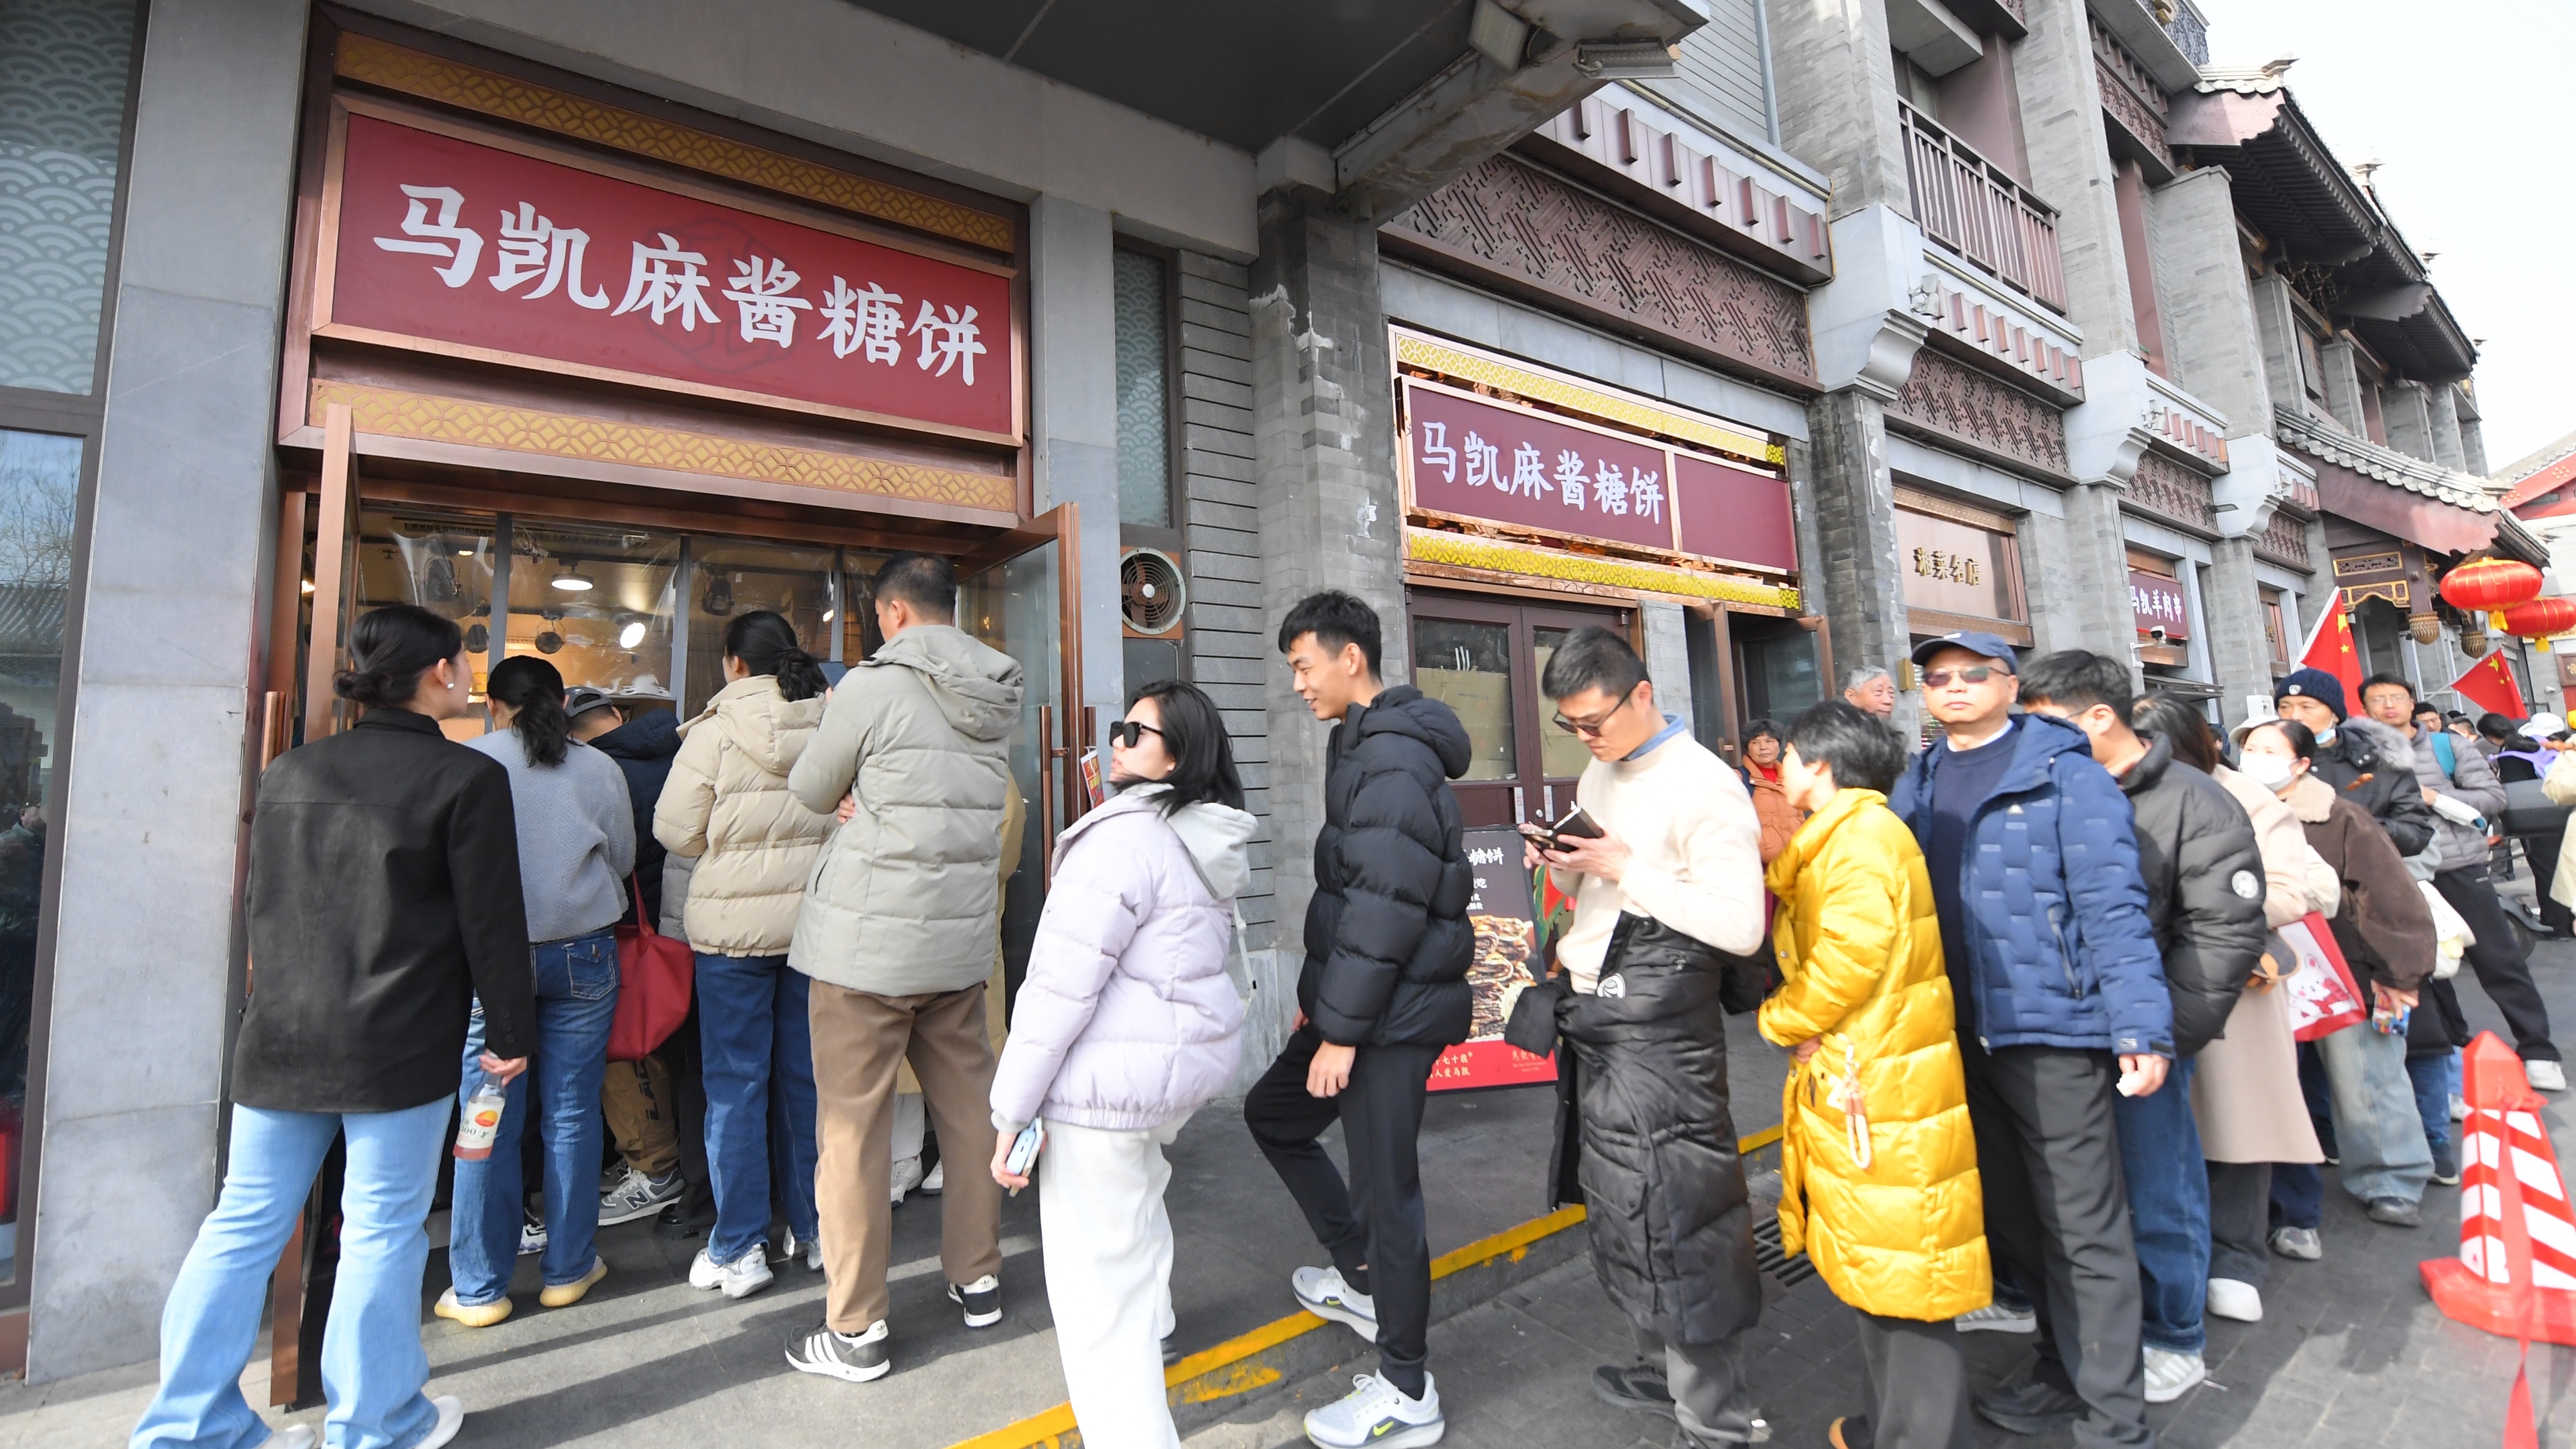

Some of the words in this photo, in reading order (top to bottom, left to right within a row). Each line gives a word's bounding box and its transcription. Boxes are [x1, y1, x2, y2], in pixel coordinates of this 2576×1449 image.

[374, 184, 987, 386] 马凯麻酱糖饼
[1421, 421, 1665, 525] 马凯麻酱糖饼
[1913, 546, 1980, 586] 湘菜名店
[2130, 585, 2182, 624] 马凯羊肉串
[1463, 847, 1504, 866] 糖饼
